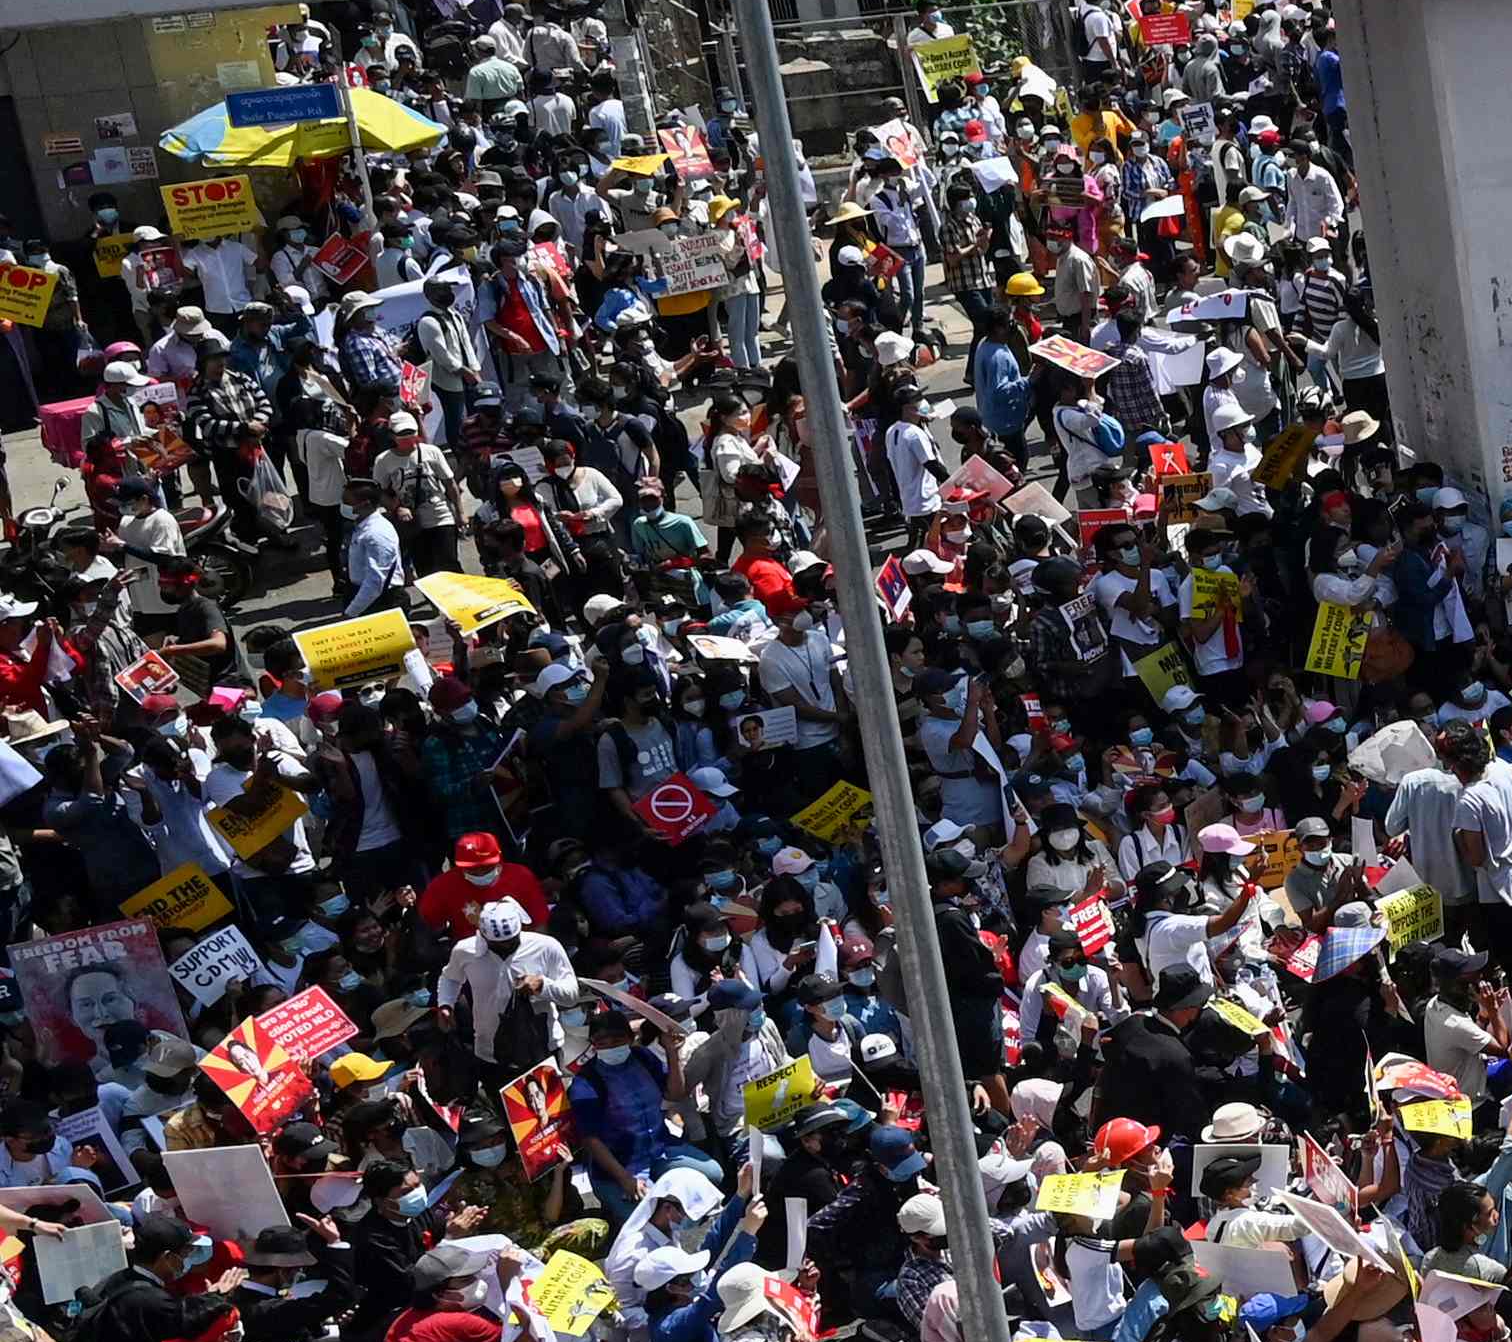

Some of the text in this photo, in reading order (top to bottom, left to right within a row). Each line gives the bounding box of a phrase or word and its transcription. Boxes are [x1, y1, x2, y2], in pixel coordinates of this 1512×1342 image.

[170, 180, 242, 207] STOP
[1062, 592, 1097, 616] FREE
[1082, 644, 1105, 662] NOW
[171, 873, 208, 899] THE
[1071, 905, 1101, 925] FREE
[1391, 914, 1420, 934] OPPOSE
[12, 922, 149, 962] FREEDOM FROM
[173, 929, 236, 978] SUPPORT
[44, 939, 129, 974] FEAR
[193, 954, 232, 988] CDM
[268, 1003, 321, 1035] VOTED NLD
[285, 999, 312, 1017] Fraud
[755, 1062, 799, 1092] RESPECT
